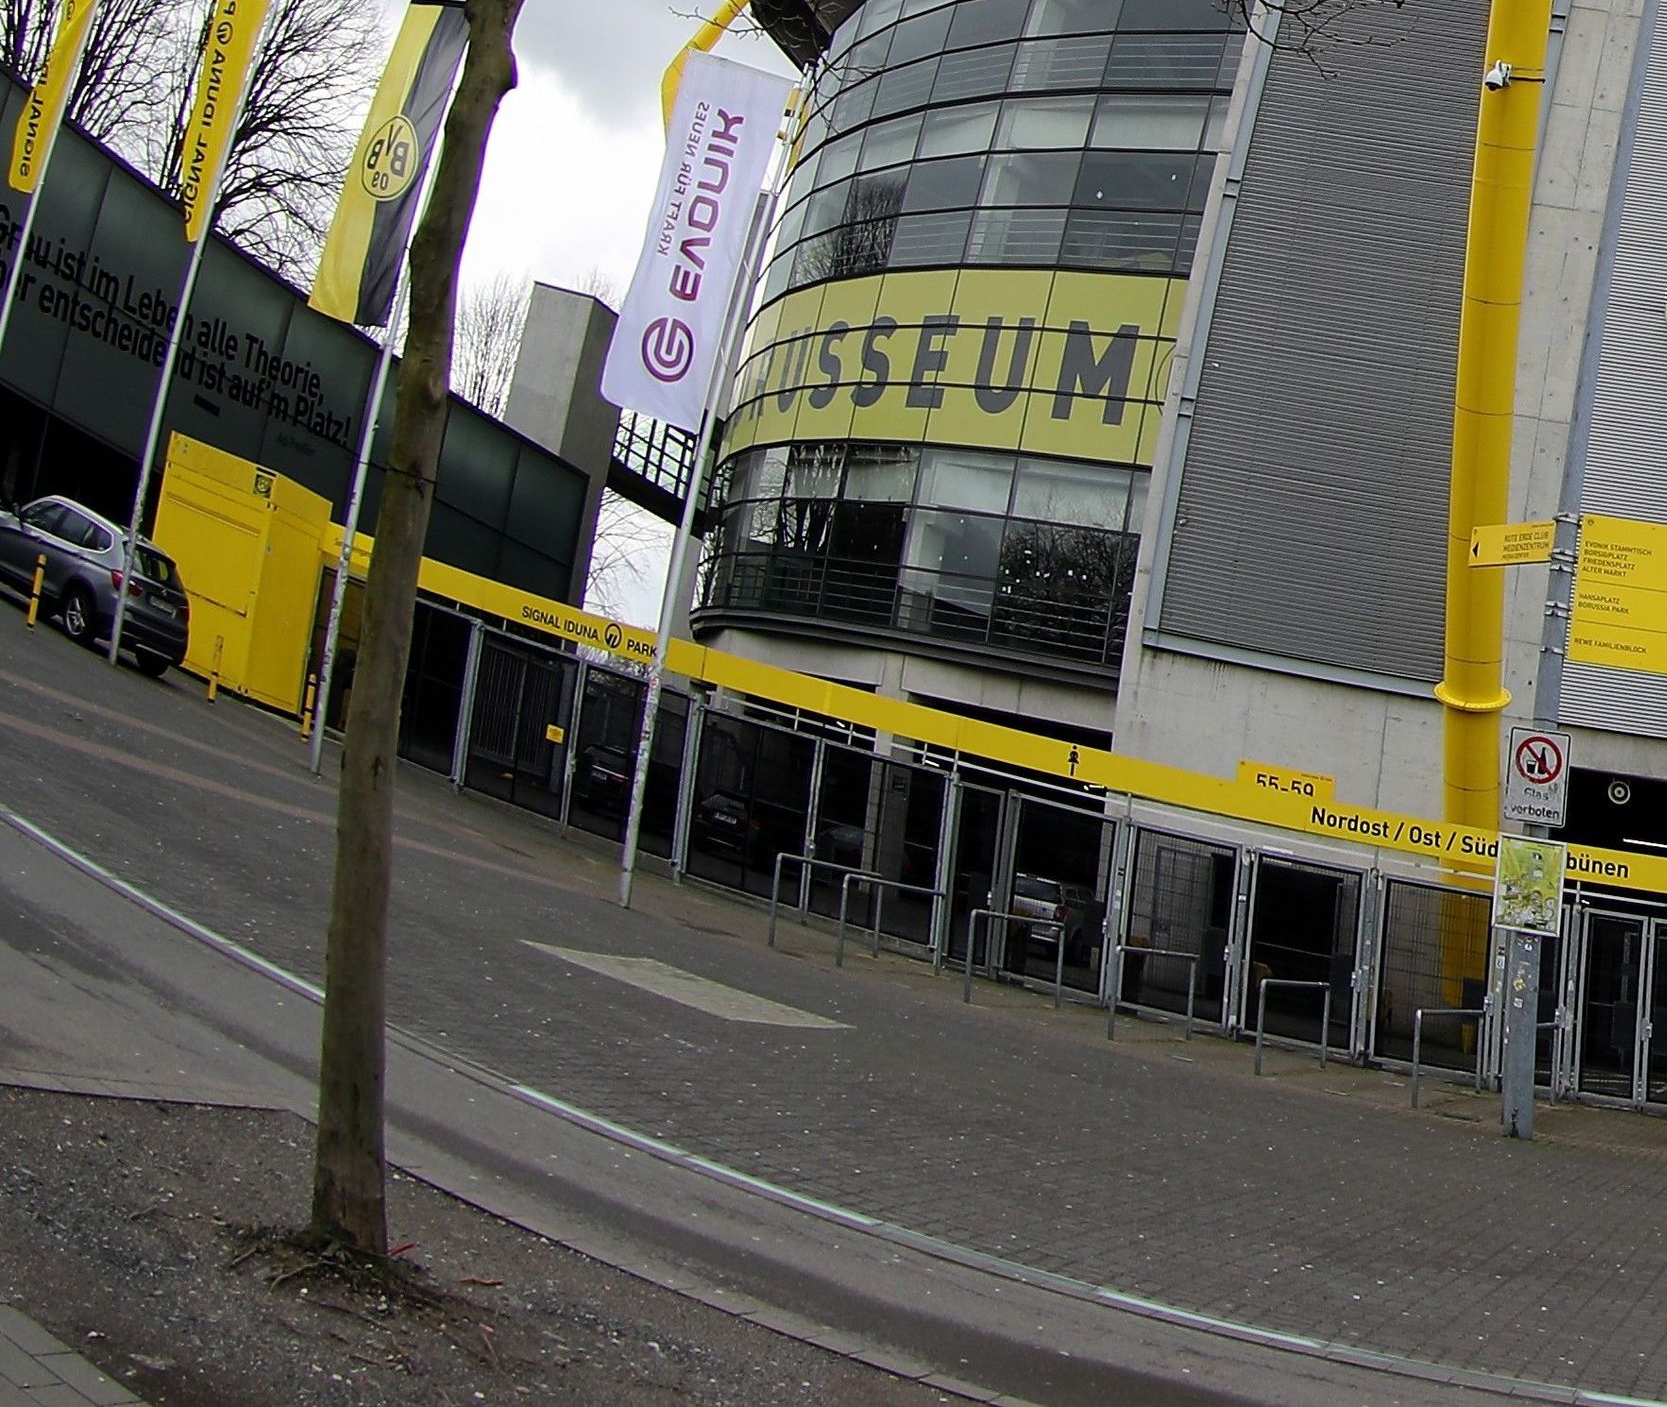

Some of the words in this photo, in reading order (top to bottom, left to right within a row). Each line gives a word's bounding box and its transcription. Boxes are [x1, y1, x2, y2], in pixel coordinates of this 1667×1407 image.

[54, 237, 86, 288] ist
[89, 256, 119, 307] im
[197, 318, 238, 361] alle
[244, 333, 324, 406] Theorie,
[198, 351, 226, 395] ist
[293, 394, 352, 448] Platz!
[1584, 549, 1628, 561] BORSIGPLATZ
[1610, 545, 1652, 556] STAMMTISCH
[1583, 558, 1635, 570] FRIEDENSPLATZ
[1582, 566, 1602, 576] ALTER
[1603, 569, 1626, 578] MARKT
[1579, 593, 1620, 605] HANSAPLATZ
[1578, 602, 1610, 612] BORUSSIA
[1611, 606, 1629, 615] PARK
[522, 605, 560, 630] SIGNAL
[563, 619, 600, 642] IDUNA
[626, 638, 658, 658] PARK
[1594, 639, 1647, 654] FAMILIENBLOCK
[1510, 804, 1560, 820] verboten
[1312, 807, 1390, 839] Nordost
[1408, 826, 1442, 849] Ost
